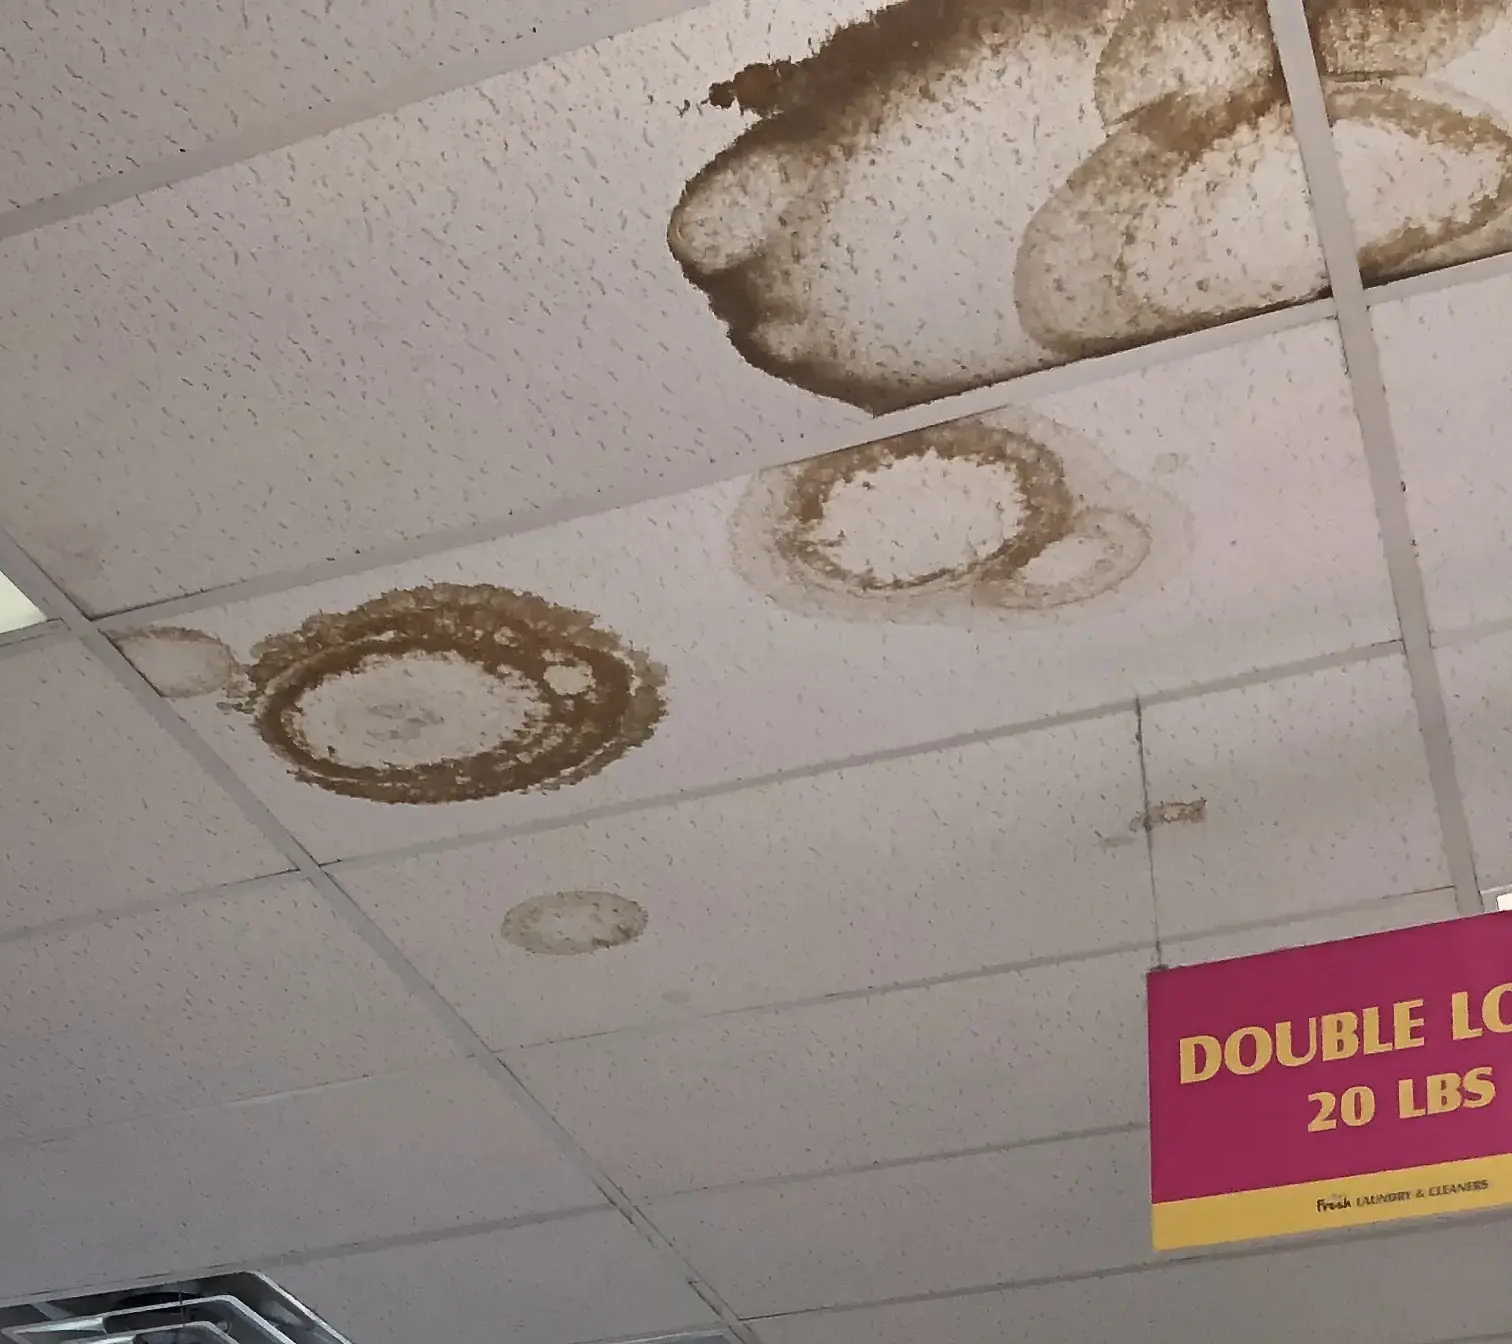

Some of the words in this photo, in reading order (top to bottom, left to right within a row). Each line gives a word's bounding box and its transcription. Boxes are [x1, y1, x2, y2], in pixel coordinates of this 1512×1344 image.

[1179, 998, 1425, 1084] DOUBLE
[1307, 1085, 1376, 1133] 20
[1398, 1066, 1498, 1120] LBS
[1428, 1179, 1489, 1197] CLEANERS
